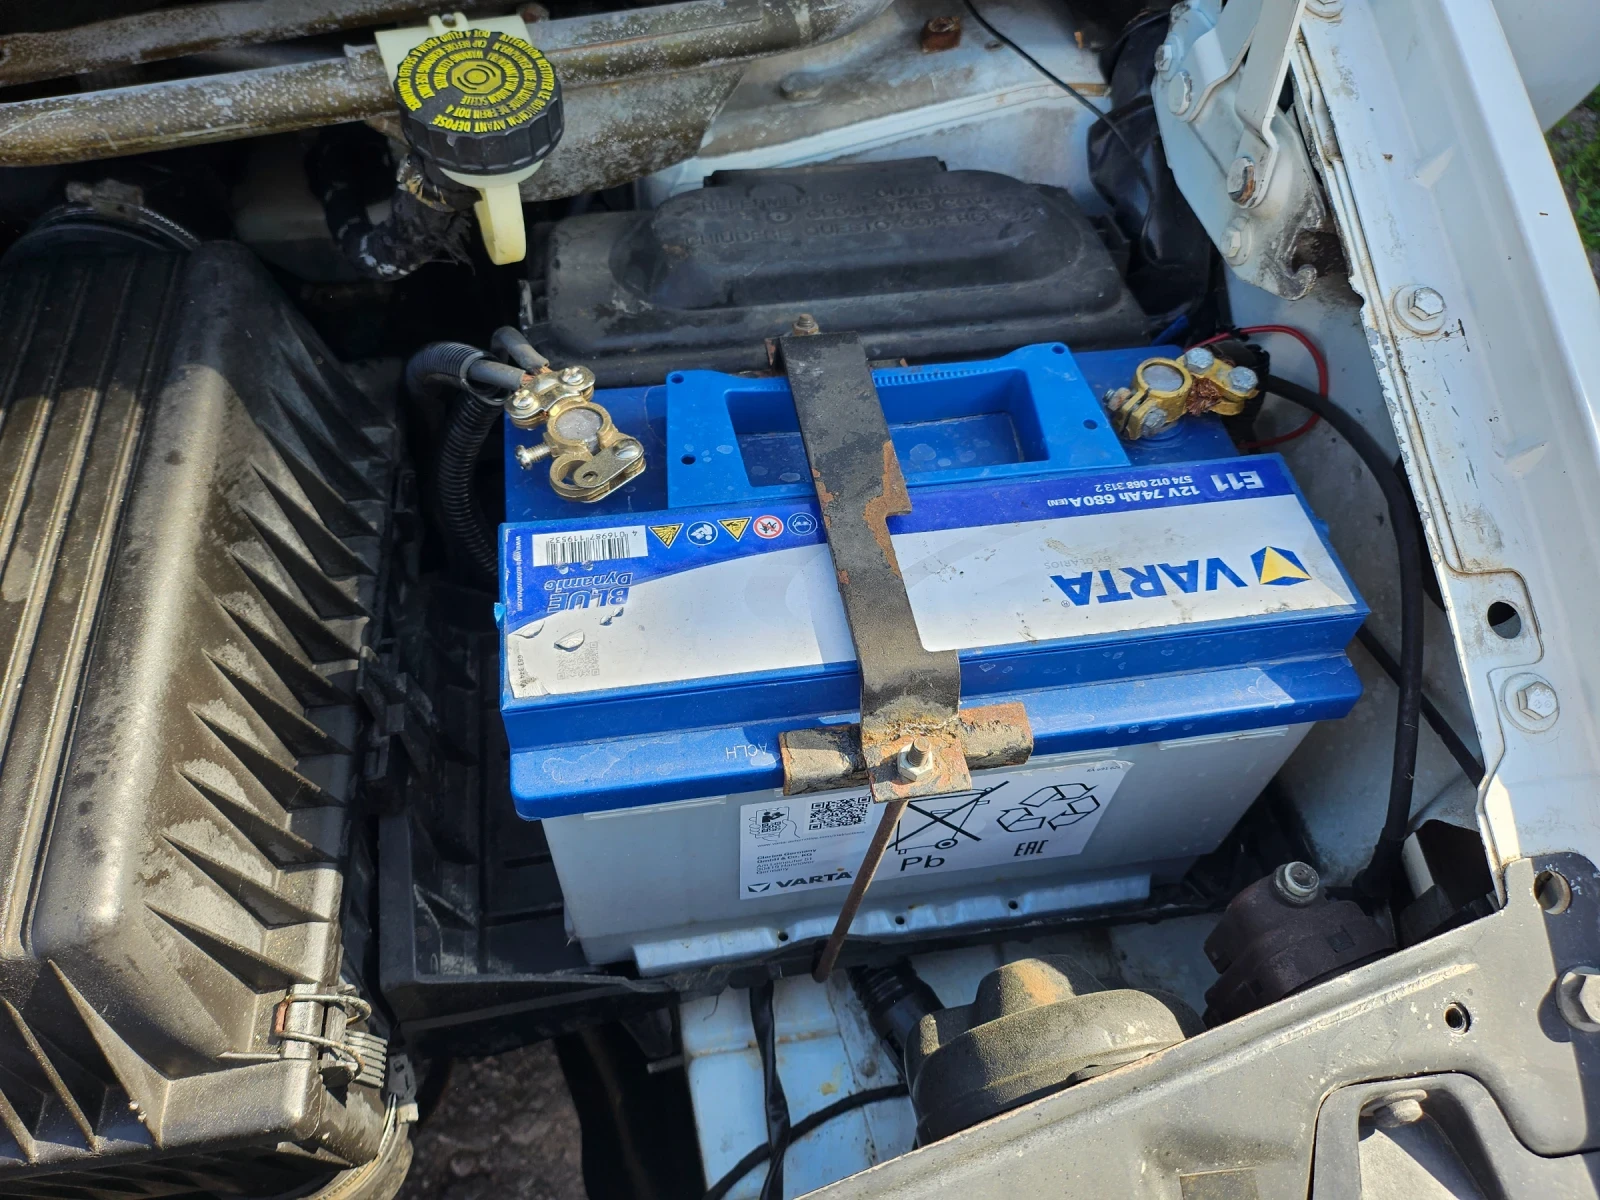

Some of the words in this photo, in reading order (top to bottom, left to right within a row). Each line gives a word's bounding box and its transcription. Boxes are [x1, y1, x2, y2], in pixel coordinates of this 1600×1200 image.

[1125, 479, 1147, 489] 068
[1148, 477, 1170, 487] 012
[1170, 474, 1193, 485] 574
[1210, 470, 1264, 492] E11
[1094, 484, 1103, 493] 2
[1103, 482, 1125, 492] 313
[1167, 484, 1201, 498] 12V
[1119, 487, 1165, 502] 74Ah
[549, 535, 584, 544] 119532
[590, 532, 626, 541] 016987
[543, 571, 633, 593] Dynamic
[1050, 556, 1249, 607] VARTA
[547, 586, 630, 613] BLUE
[899, 854, 946, 873] Pb
[775, 871, 852, 888] VARTA
